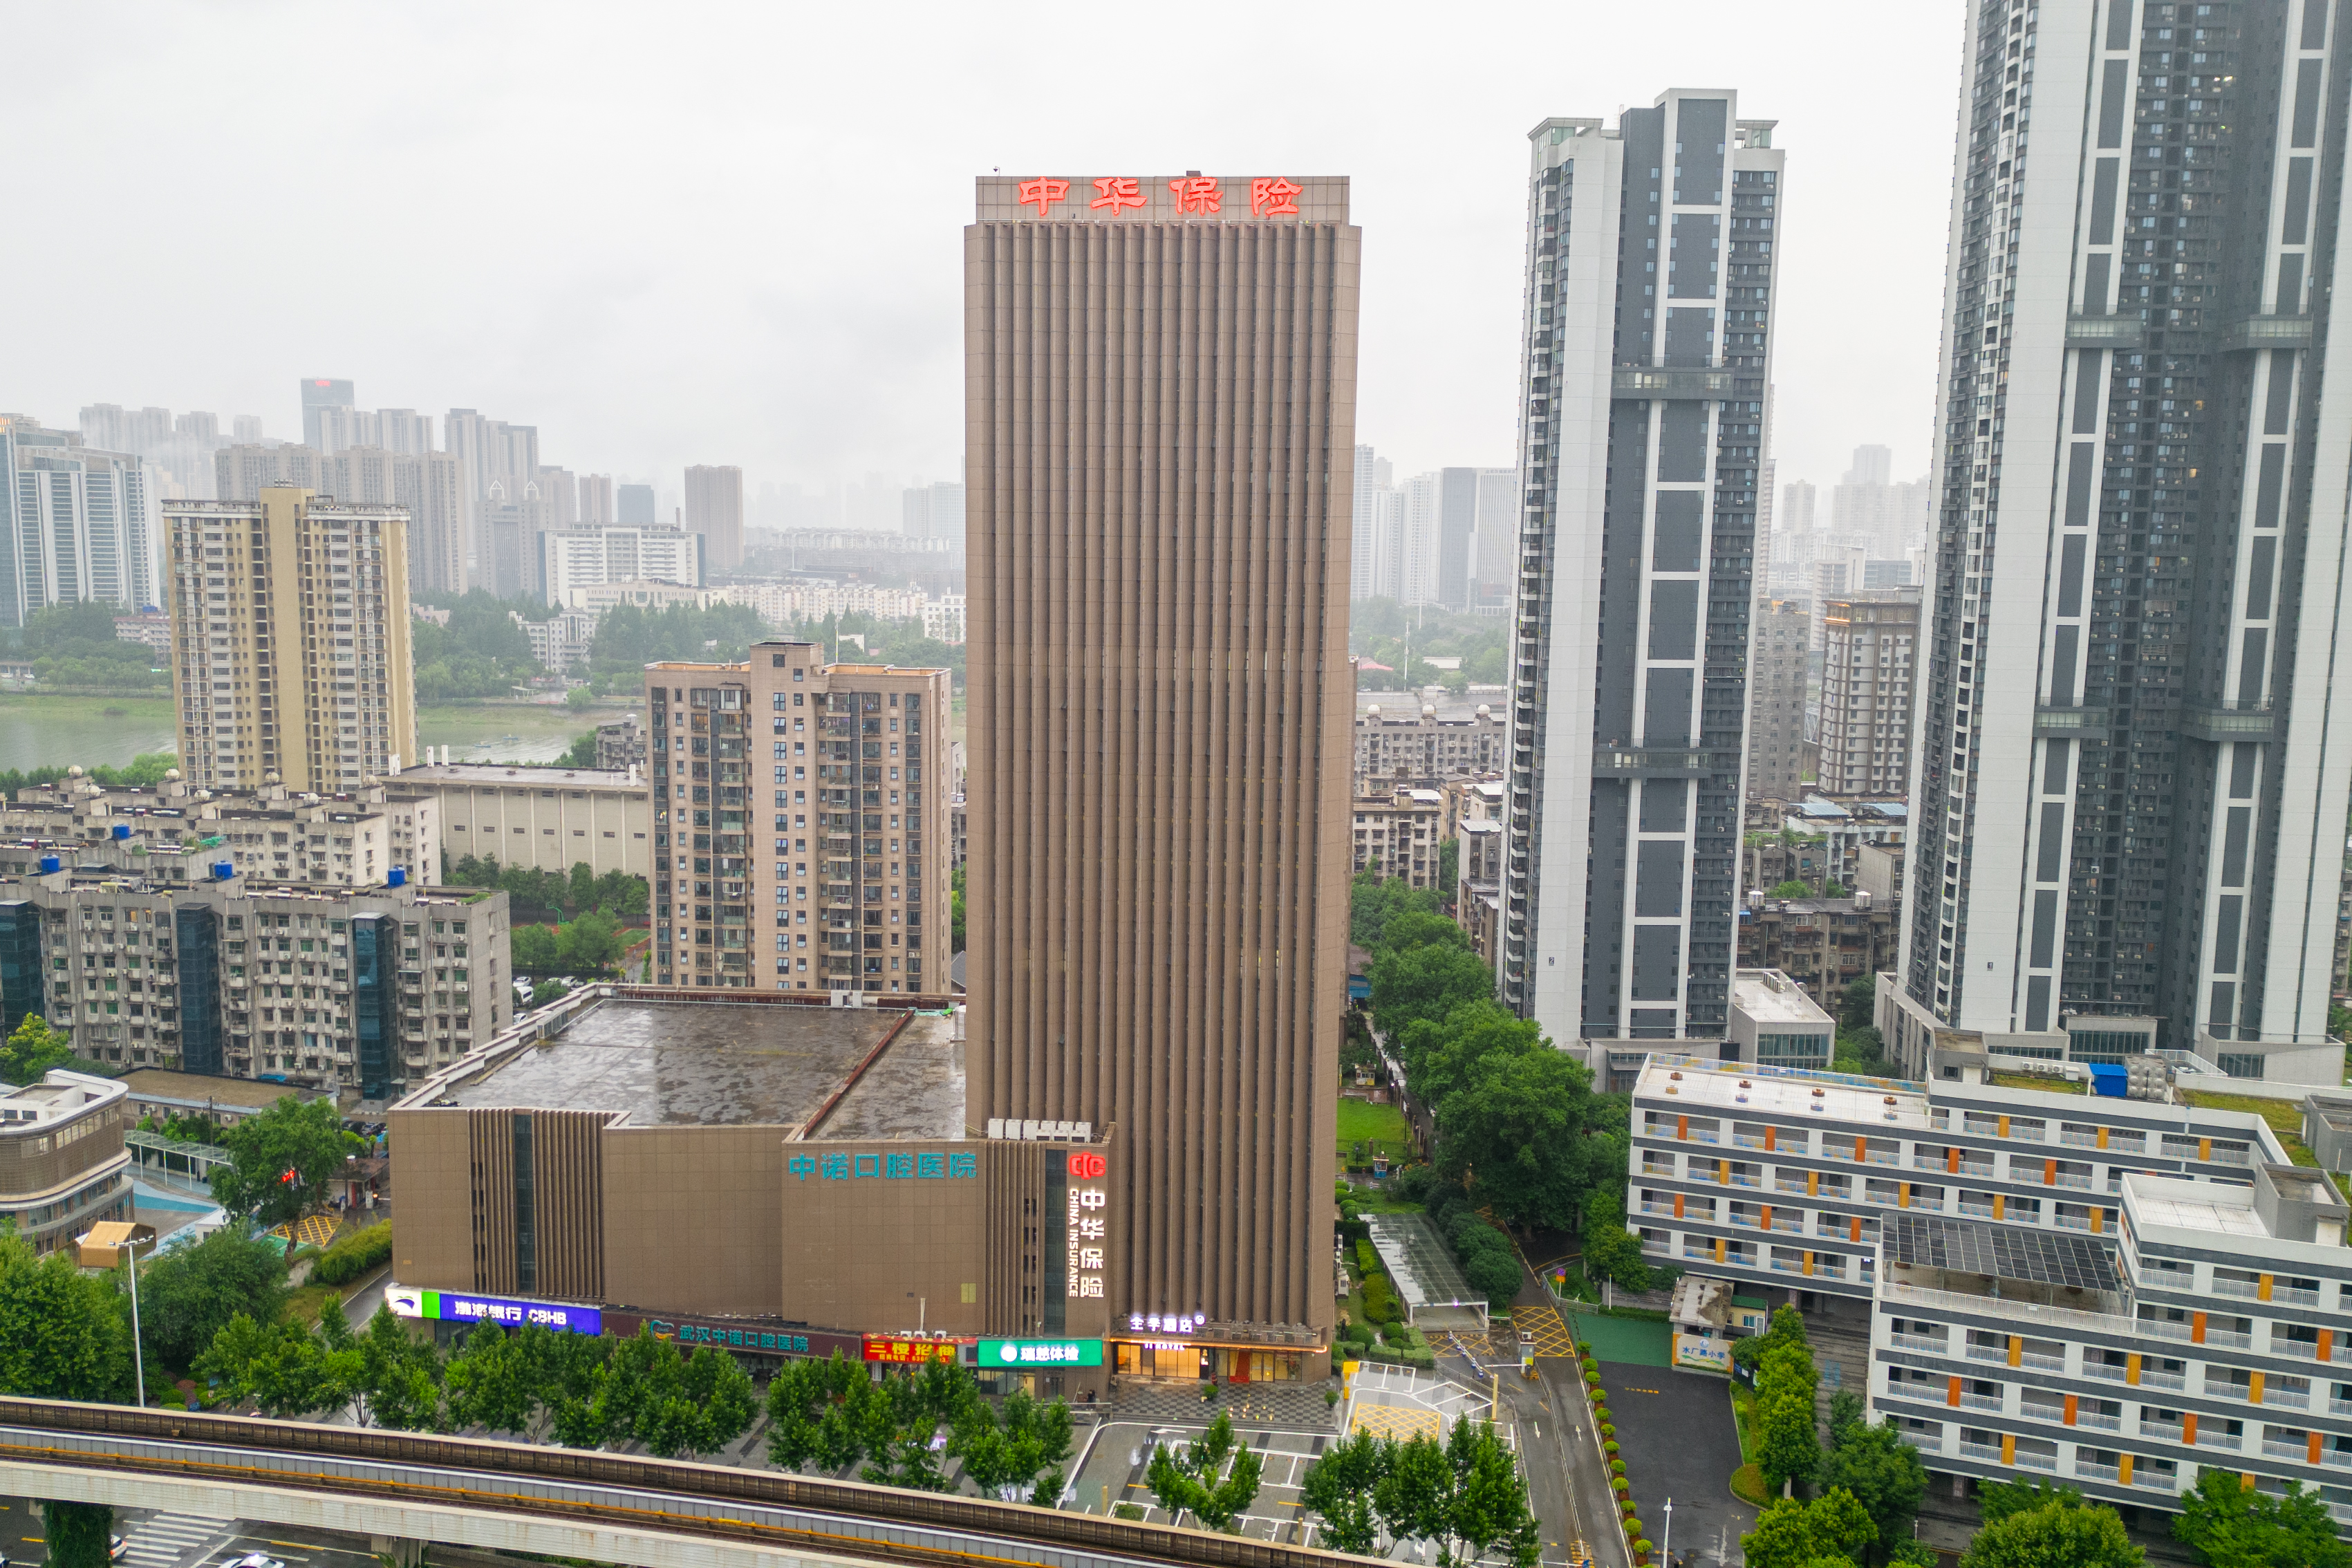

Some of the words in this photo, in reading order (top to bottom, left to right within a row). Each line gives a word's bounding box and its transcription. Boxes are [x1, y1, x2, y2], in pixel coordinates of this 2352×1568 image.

[1018, 176, 1304, 216] 中华保险
[789, 1152, 977, 1181] 中诺口腔医院
[1070, 1188, 1079, 1226] CHINA
[1080, 1189, 1105, 1298] 中华保险
[1069, 1229, 1079, 1298] INSURANCE
[528, 1309, 567, 1325] CBHB
[680, 1325, 808, 1352] 武汉中诺口腔医院
[869, 1341, 955, 1356] 三楼招商
